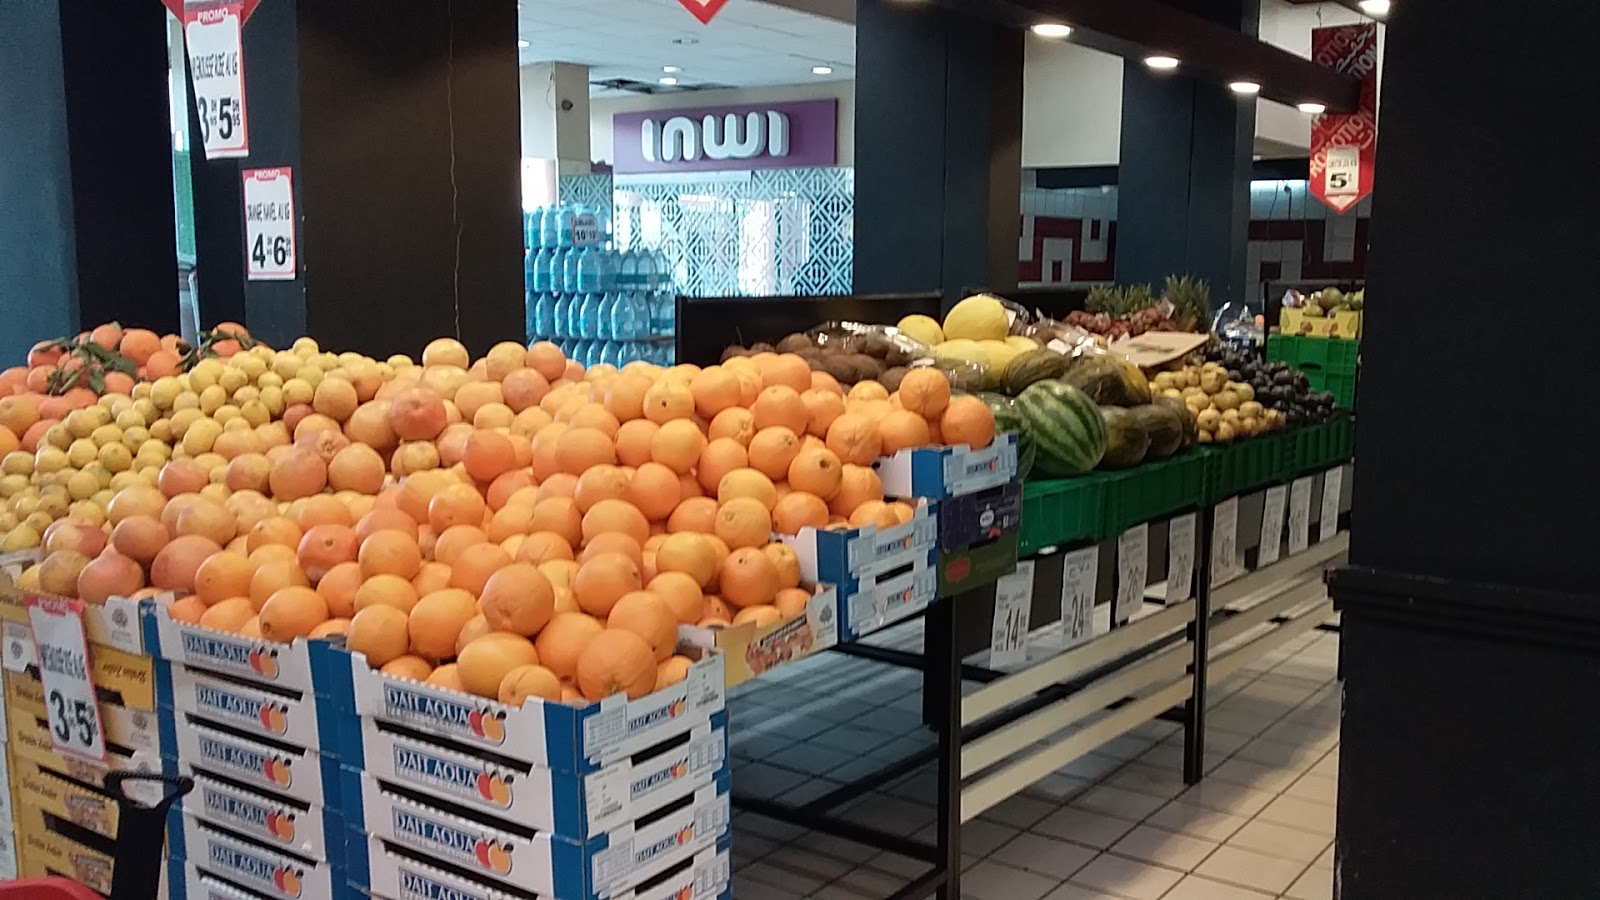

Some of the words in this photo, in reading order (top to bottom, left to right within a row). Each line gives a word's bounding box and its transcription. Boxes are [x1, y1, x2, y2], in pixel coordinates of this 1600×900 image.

[197, 7, 229, 23] PROMO
[218, 97, 233, 140] 5
[254, 169, 281, 180] PROMO
[1330, 172, 1347, 188] 5
[252, 233, 266, 269] 4
[274, 236, 286, 266] 6
[1005, 608, 1020, 651] 14
[50, 688, 70, 743] 3
[74, 700, 93, 747] 5
